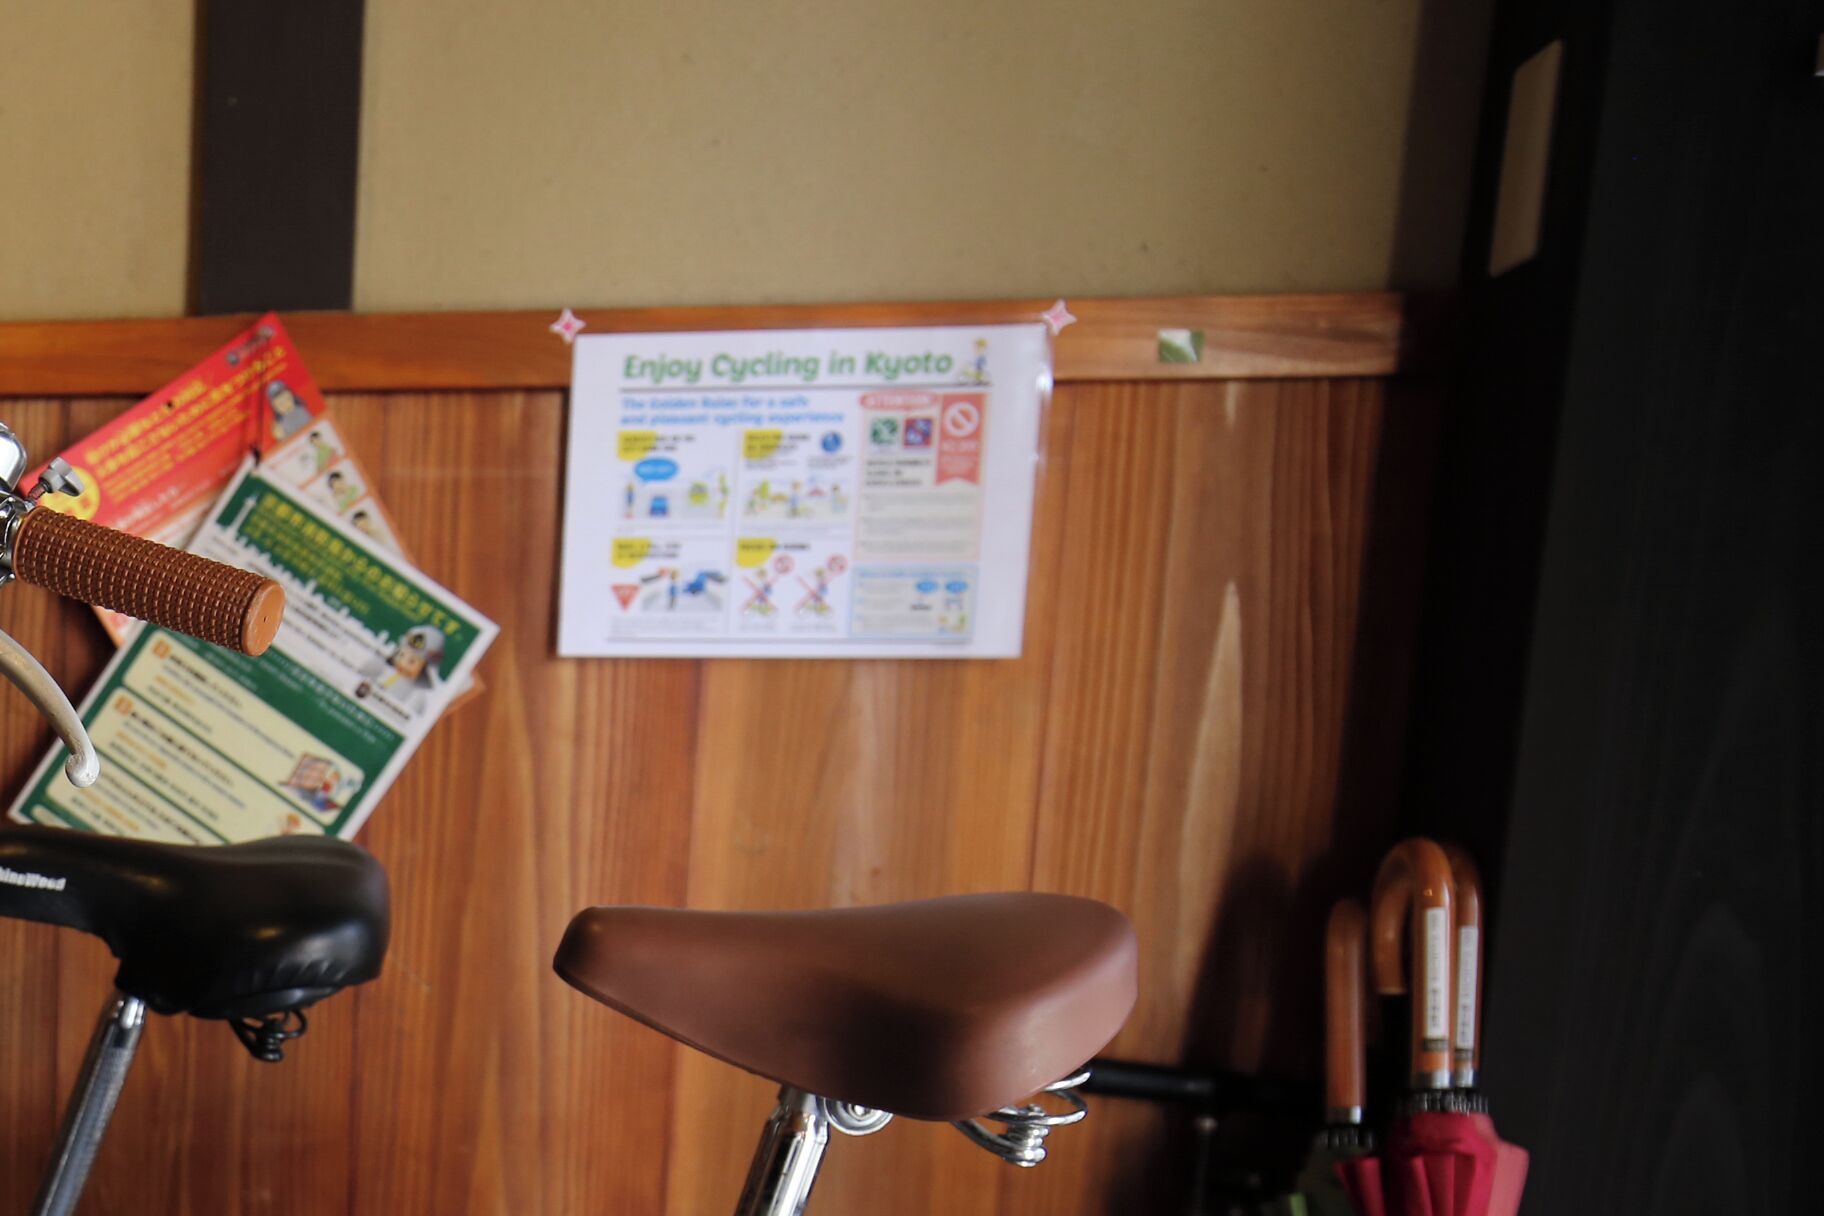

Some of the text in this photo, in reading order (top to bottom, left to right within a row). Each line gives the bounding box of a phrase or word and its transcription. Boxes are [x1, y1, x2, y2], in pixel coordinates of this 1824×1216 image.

[623, 349, 955, 384] Enjoy Cycling in Kyoto
